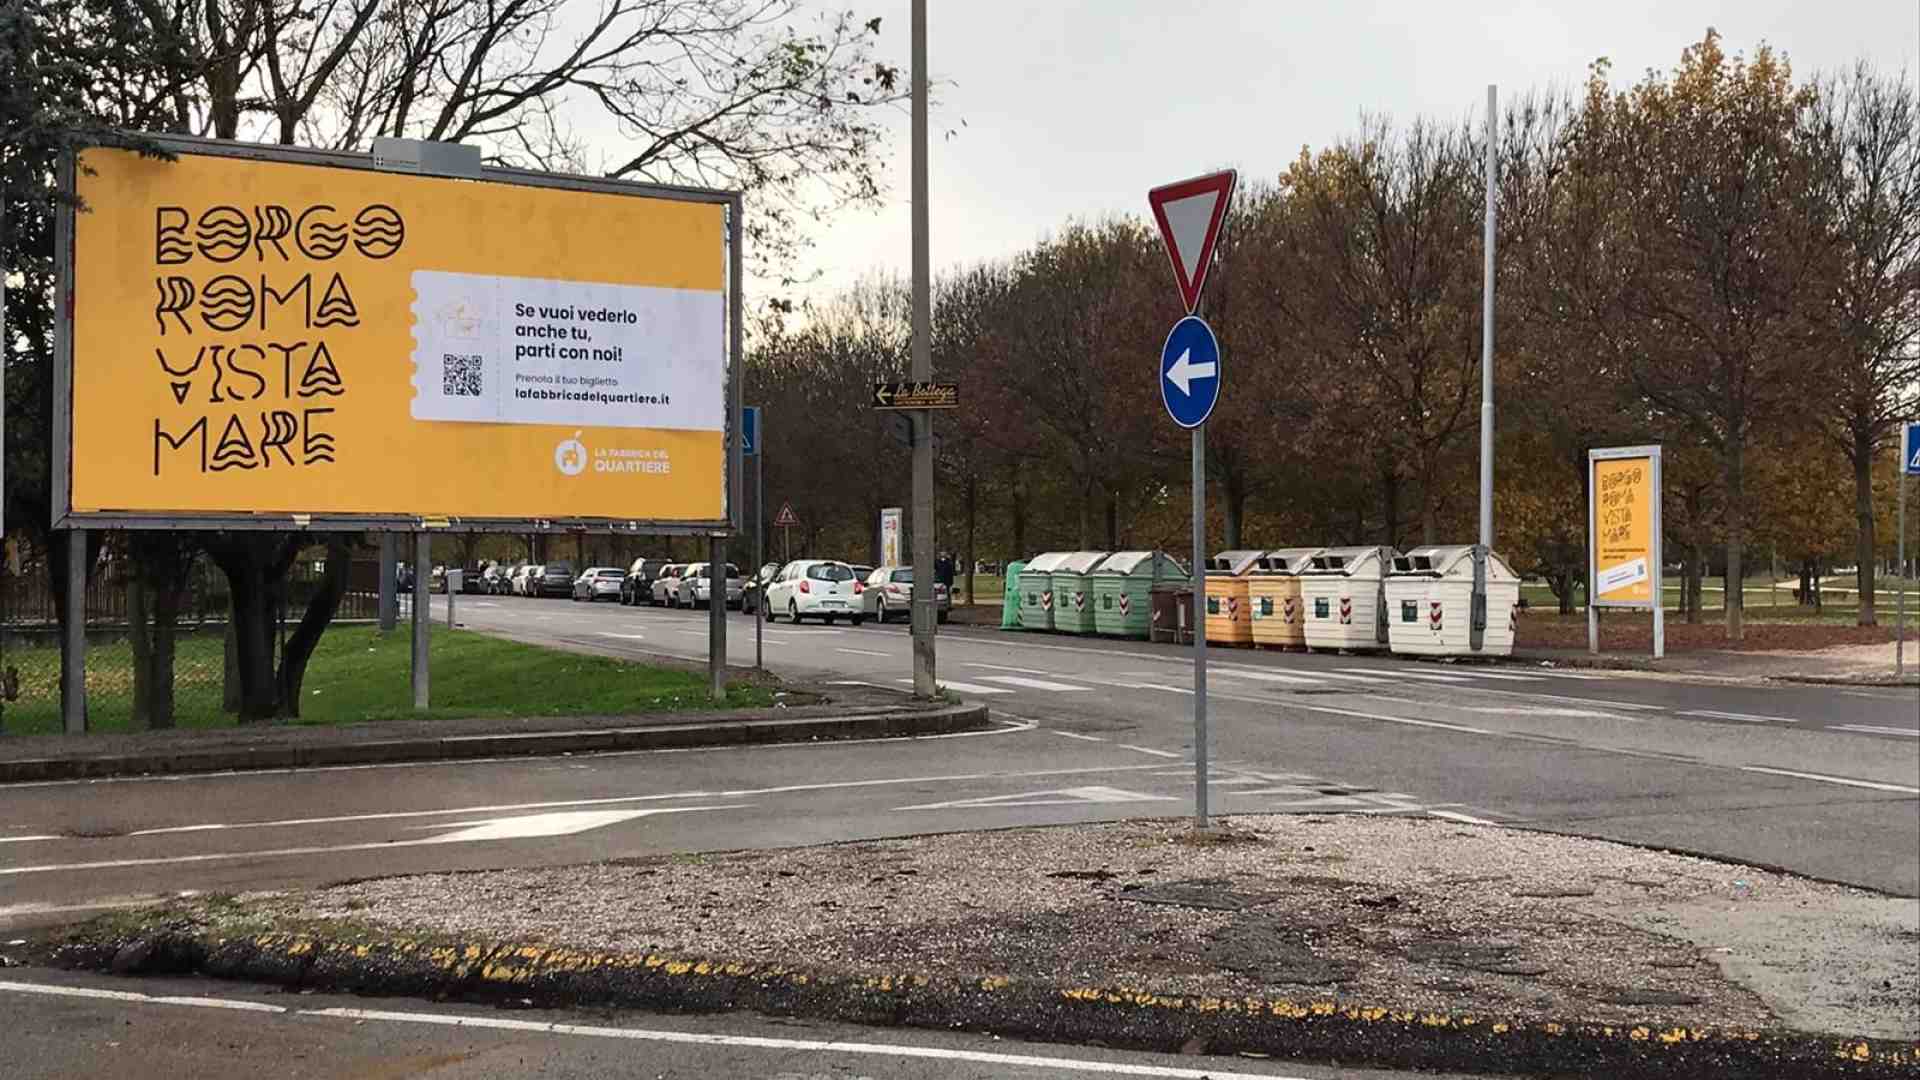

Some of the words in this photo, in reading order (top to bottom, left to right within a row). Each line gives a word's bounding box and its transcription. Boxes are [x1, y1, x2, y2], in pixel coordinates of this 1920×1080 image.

[155, 203, 405, 265] BORGO
[155, 271, 361, 336] ROMA
[515, 303, 535, 318] Se
[539, 304, 574, 320] vuoi
[577, 307, 637, 324] vederlo
[515, 323, 567, 339] anche
[571, 326, 592, 343] tu,
[515, 342, 555, 361] parti
[559, 347, 589, 360] con
[593, 345, 623, 362] noi!
[155, 340, 345, 405] VISTA
[515, 373, 553, 384] Prenota
[562, 376, 578, 385] tuo
[579, 375, 618, 388] biglietto
[515, 387, 670, 405] lafabbricadelquartiere.it
[154, 407, 336, 477] MARE
[594, 458, 671, 474] QUARTIERE
